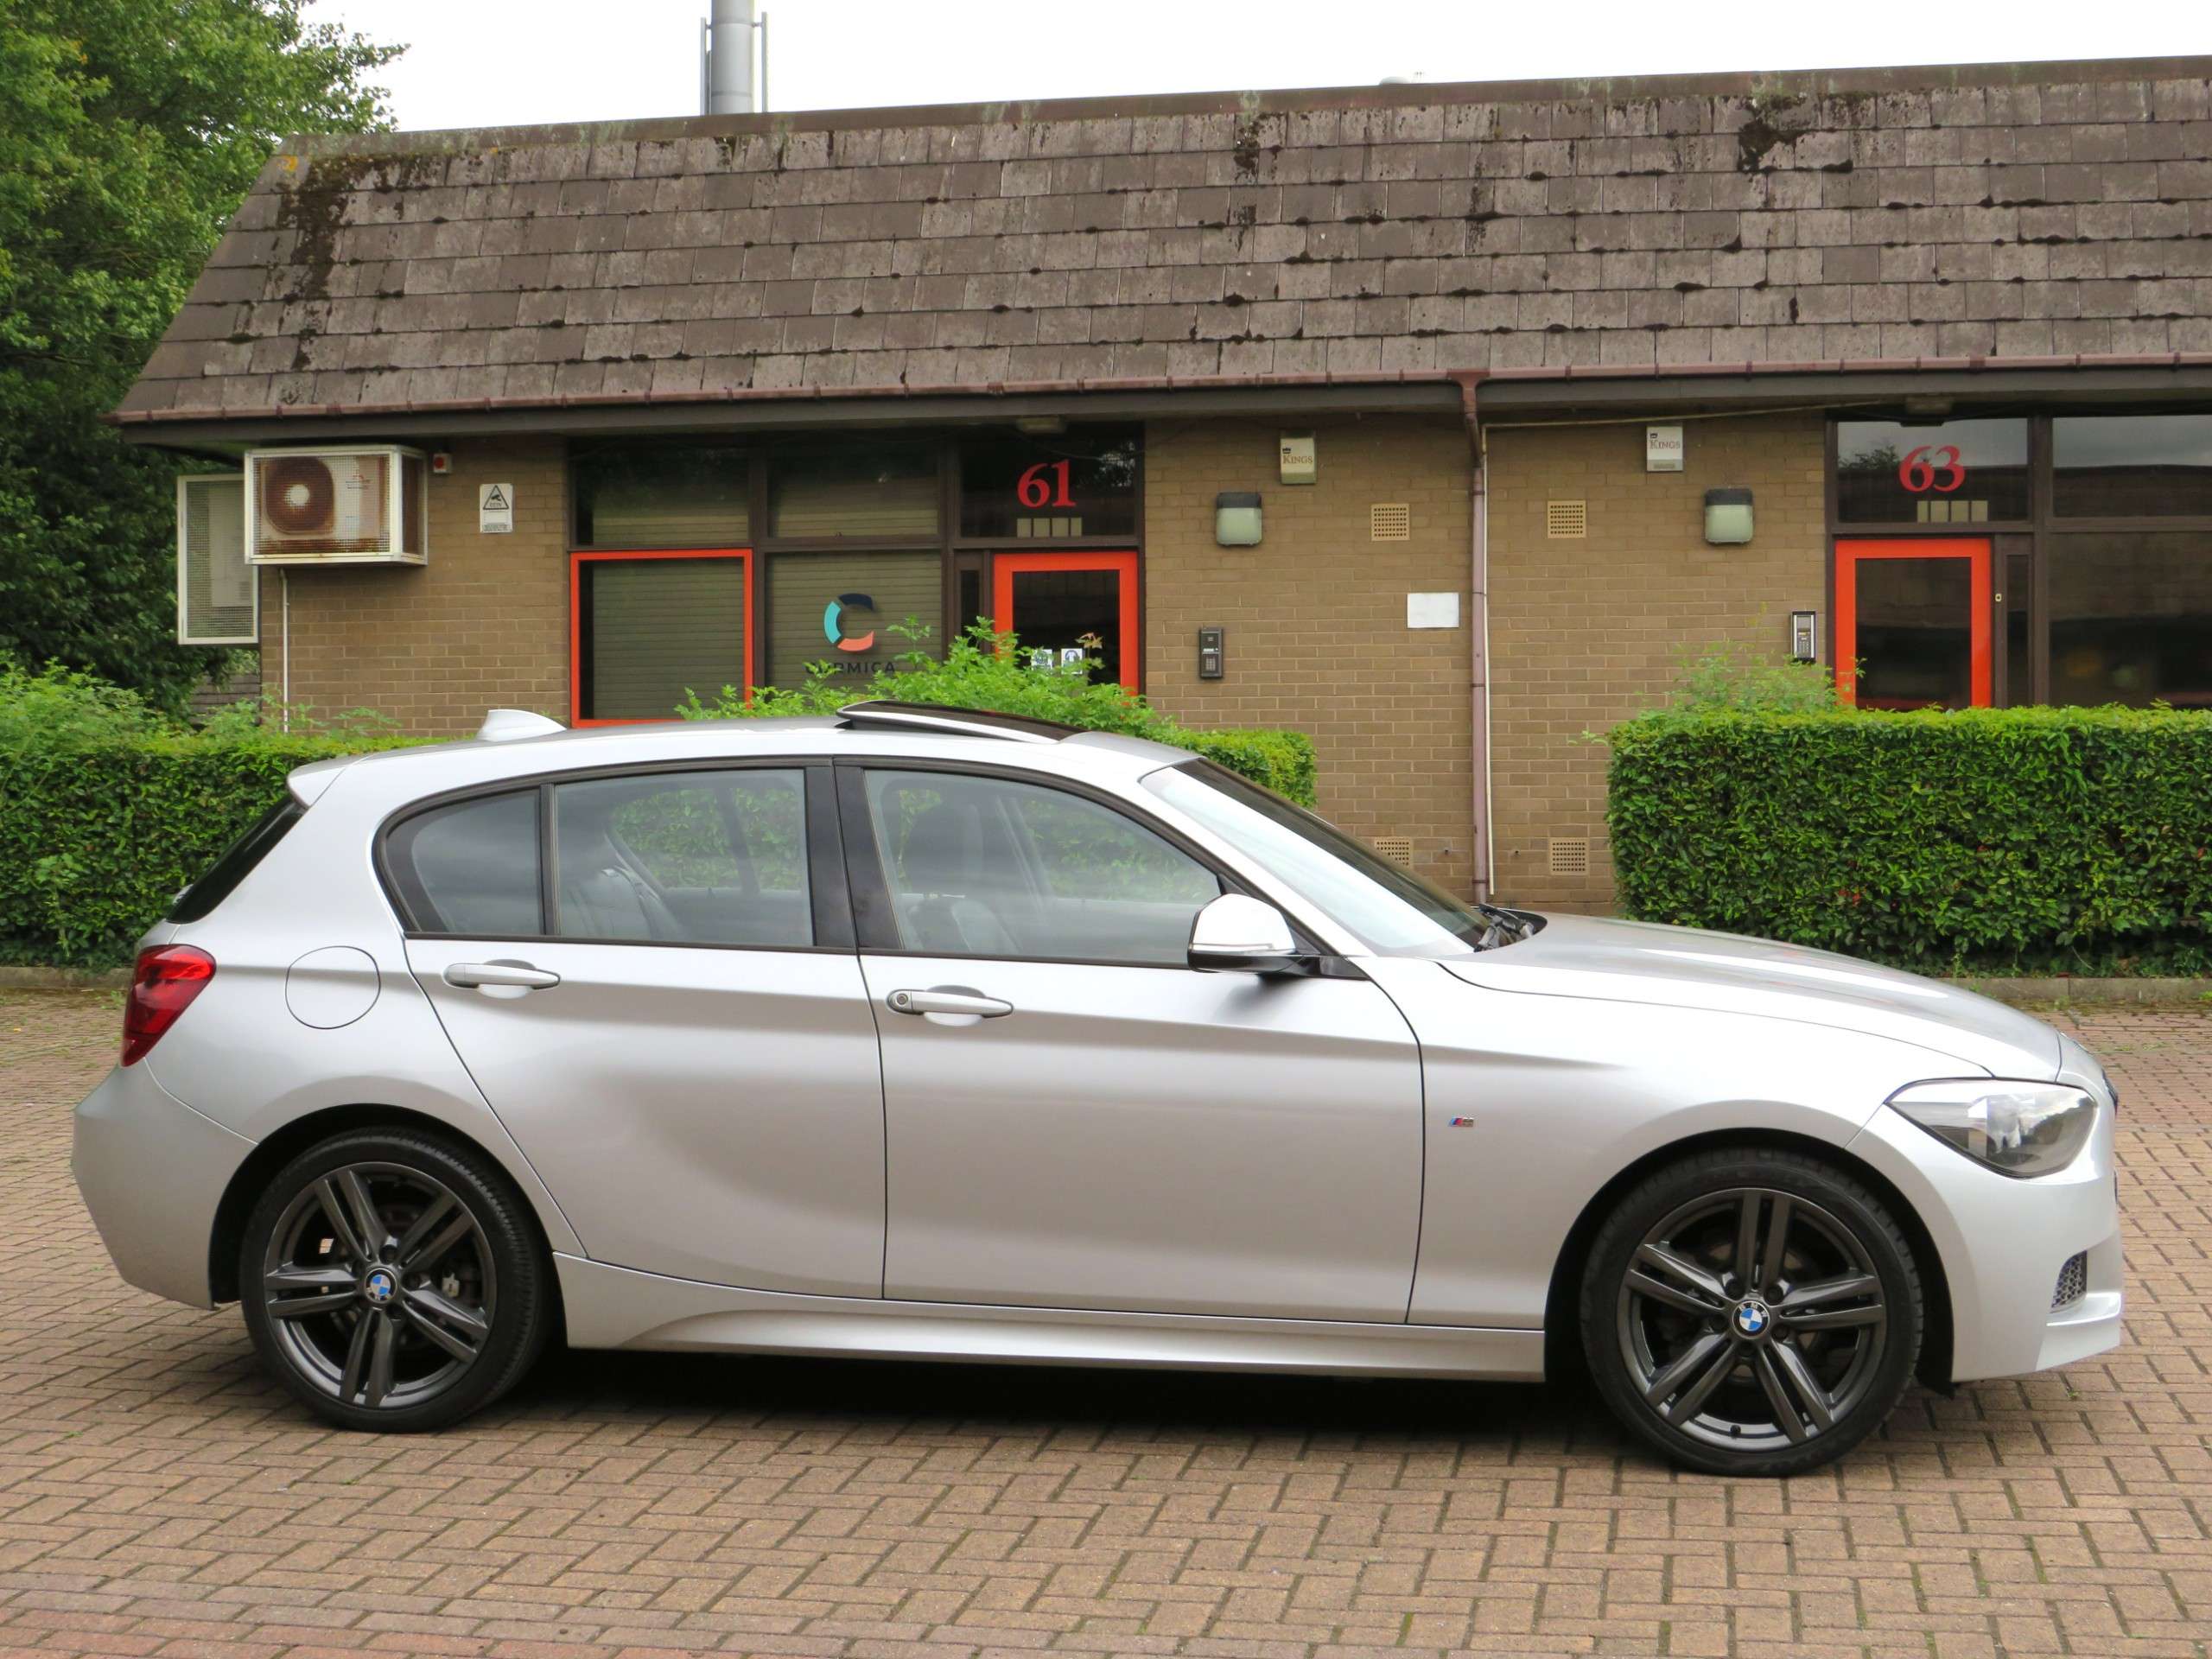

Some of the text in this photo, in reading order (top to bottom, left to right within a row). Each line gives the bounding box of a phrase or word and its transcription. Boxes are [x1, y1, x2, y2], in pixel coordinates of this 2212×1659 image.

[1649, 439, 1681, 449] KINGS
[1282, 454, 1313, 464] KINGS
[1899, 444, 1966, 493] 63
[1017, 459, 1076, 508] 61
